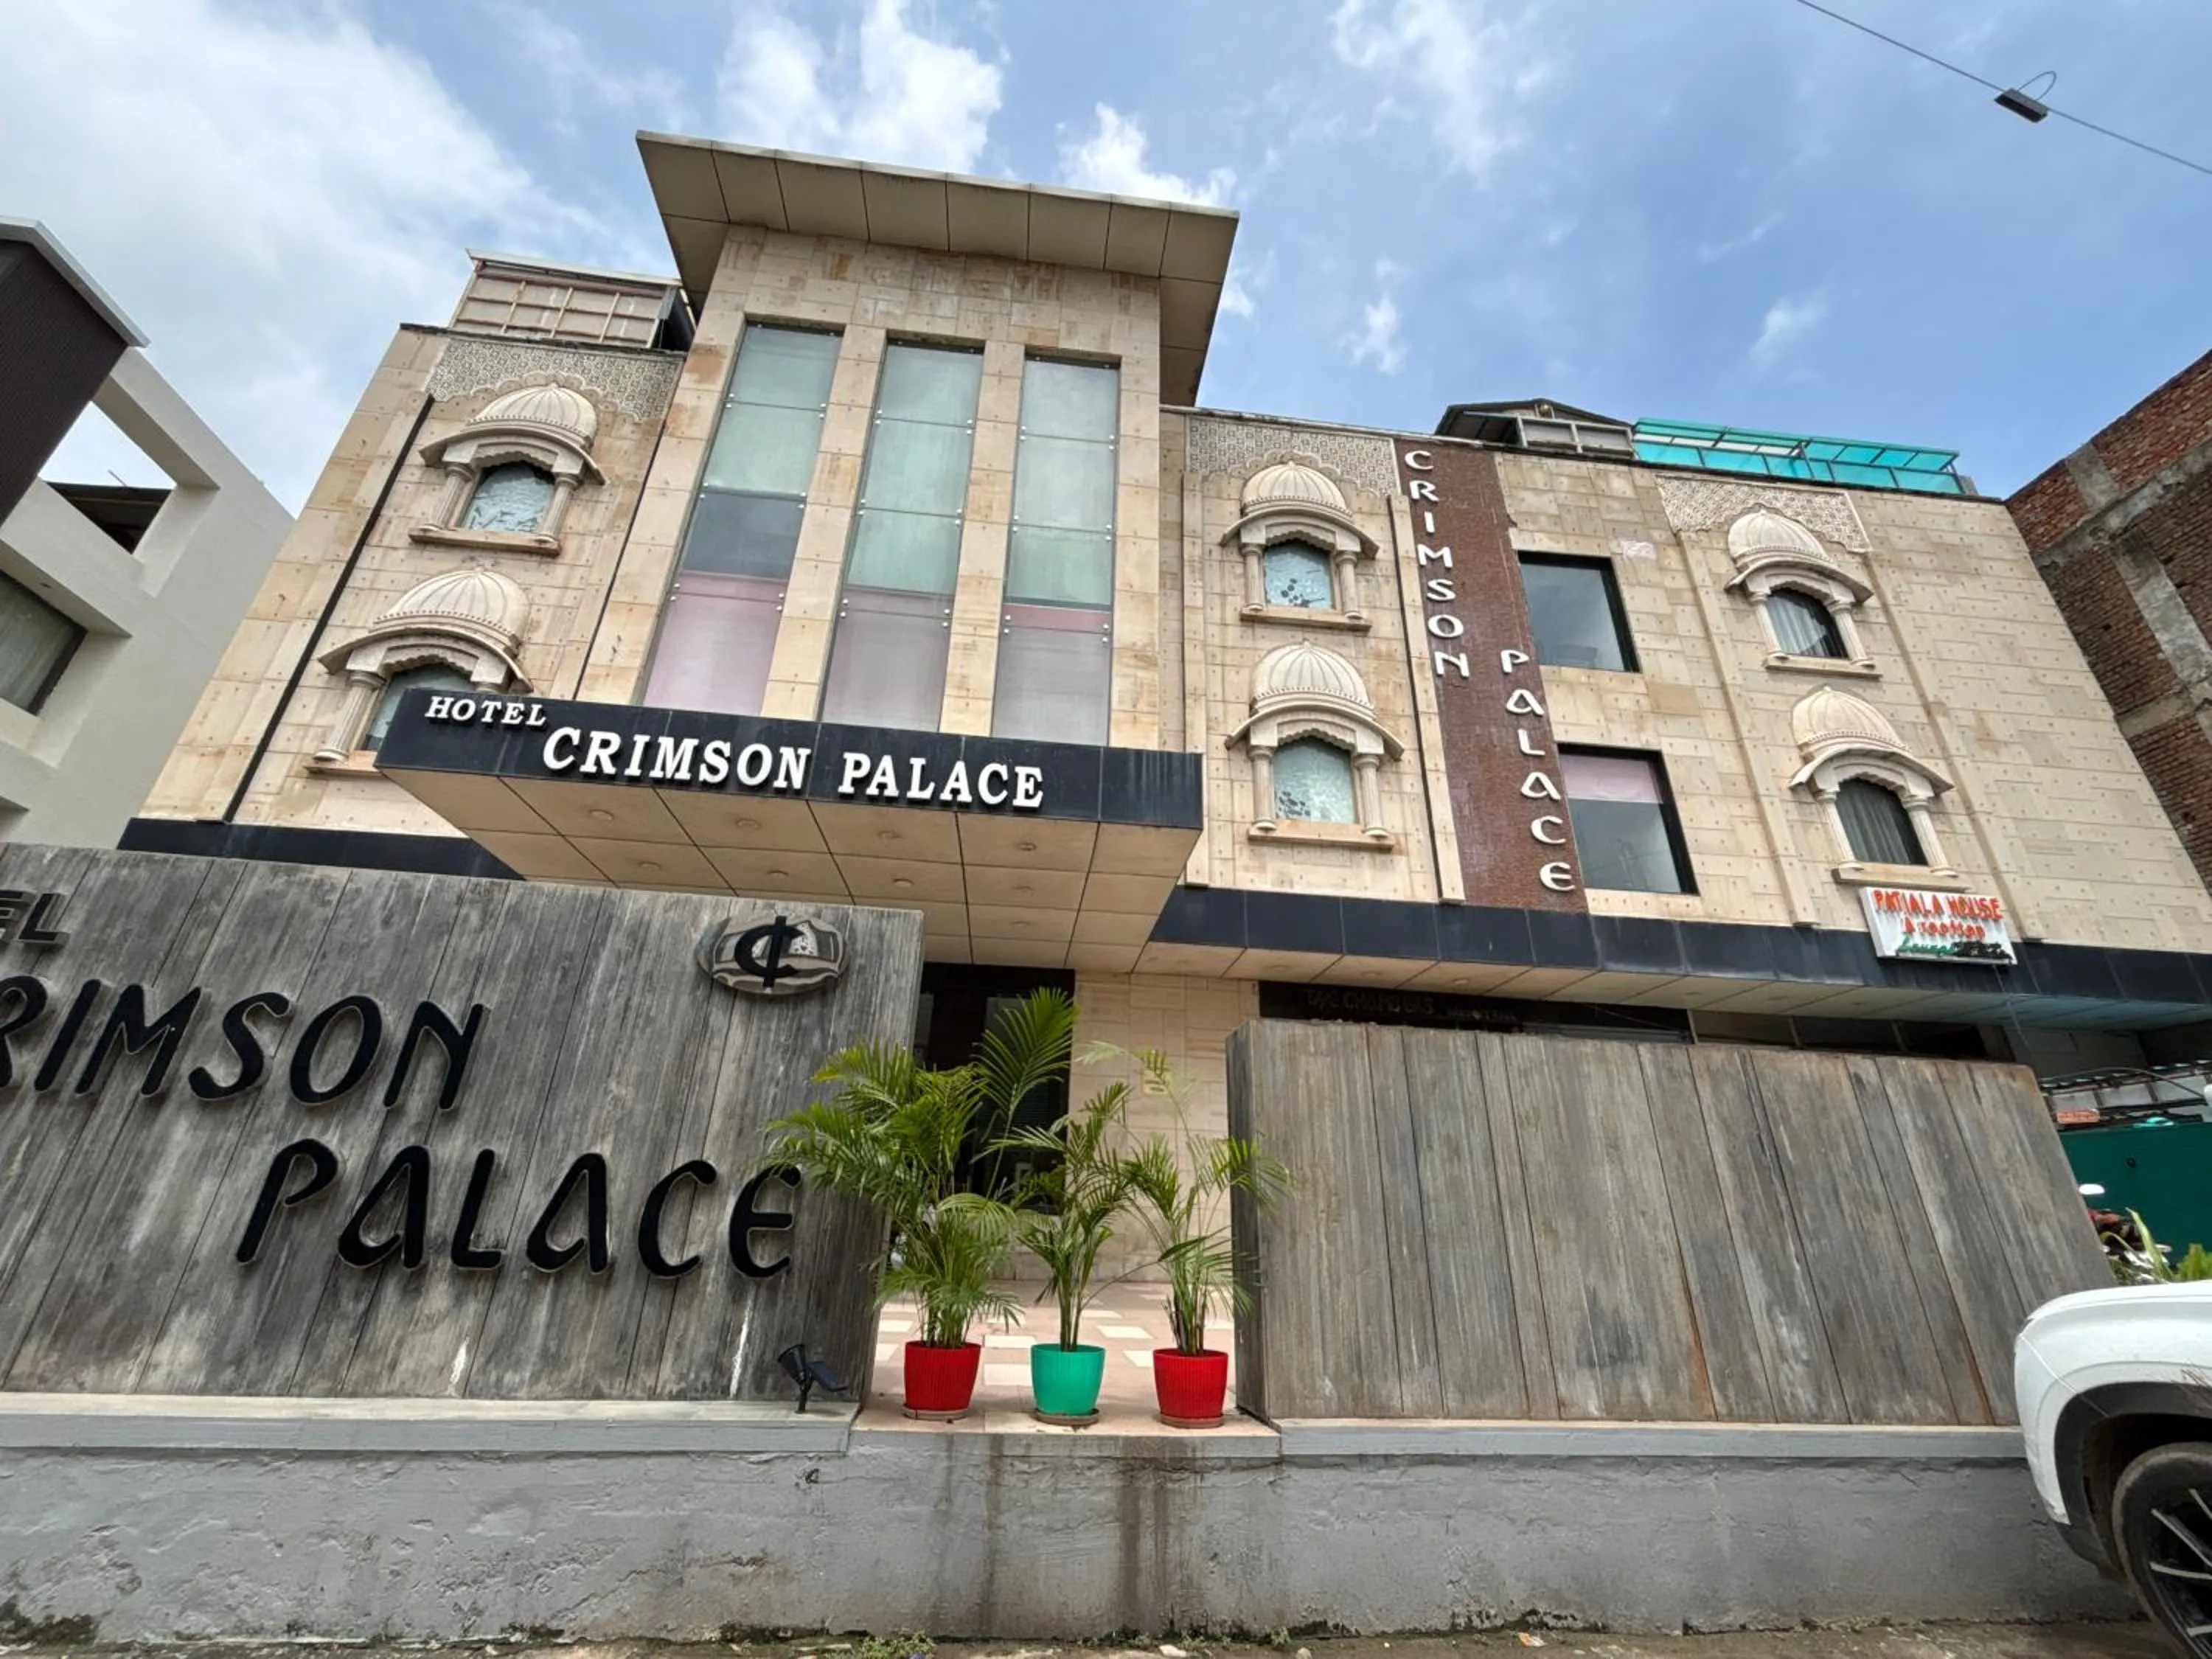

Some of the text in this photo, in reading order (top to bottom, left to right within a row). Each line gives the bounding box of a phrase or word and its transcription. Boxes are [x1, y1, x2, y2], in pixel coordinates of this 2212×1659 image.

[1404, 450, 1470, 679] CRIMSON
[424, 695, 547, 728] HOTEL
[542, 726, 1043, 810] CRIMSON PALACE
[1501, 650, 1576, 892] PALACE
[1946, 894, 2004, 920] HOUSE
[236, 1138, 801, 1279] PALACE
